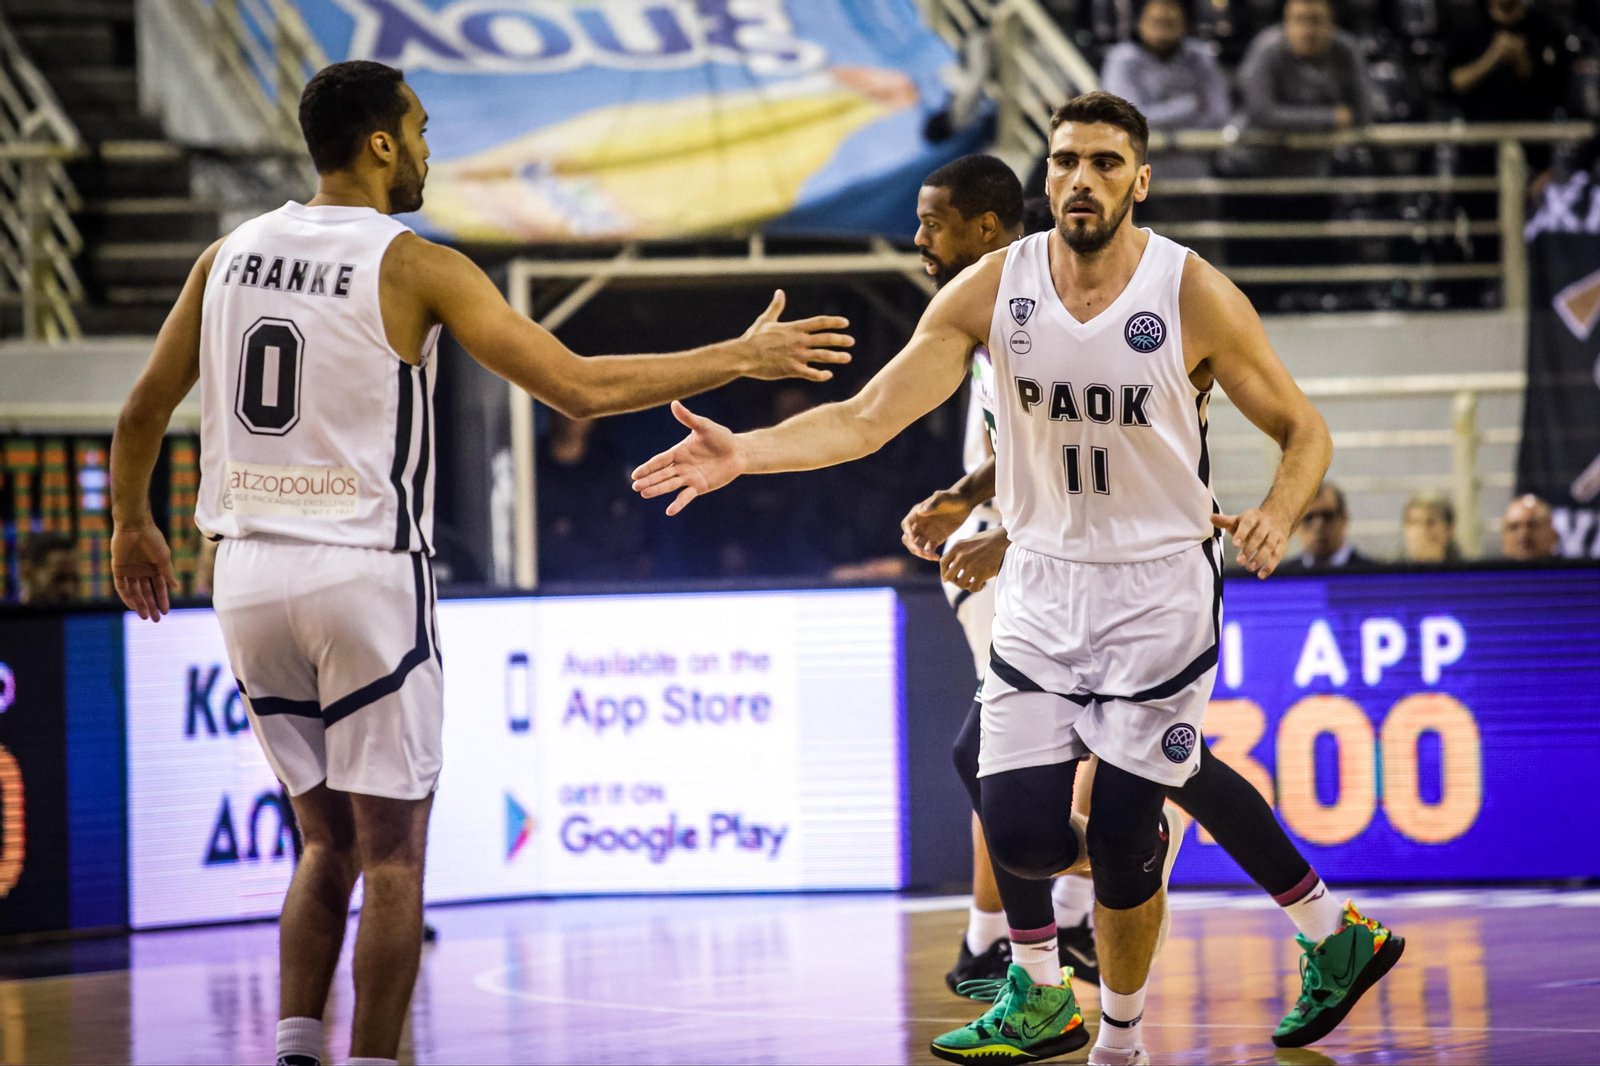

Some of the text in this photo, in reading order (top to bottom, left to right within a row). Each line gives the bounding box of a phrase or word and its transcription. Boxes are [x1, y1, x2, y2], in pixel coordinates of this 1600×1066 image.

[223, 252, 356, 298] FRANKE
[235, 316, 305, 436] 0
[1014, 376, 1153, 427] PAOK
[230, 470, 356, 497] atzopoulos
[1062, 445, 1110, 495] 11
[1293, 614, 1467, 688] APP
[563, 685, 771, 735] App Store
[1182, 692, 1482, 846] 300
[560, 811, 789, 864] Google Play
